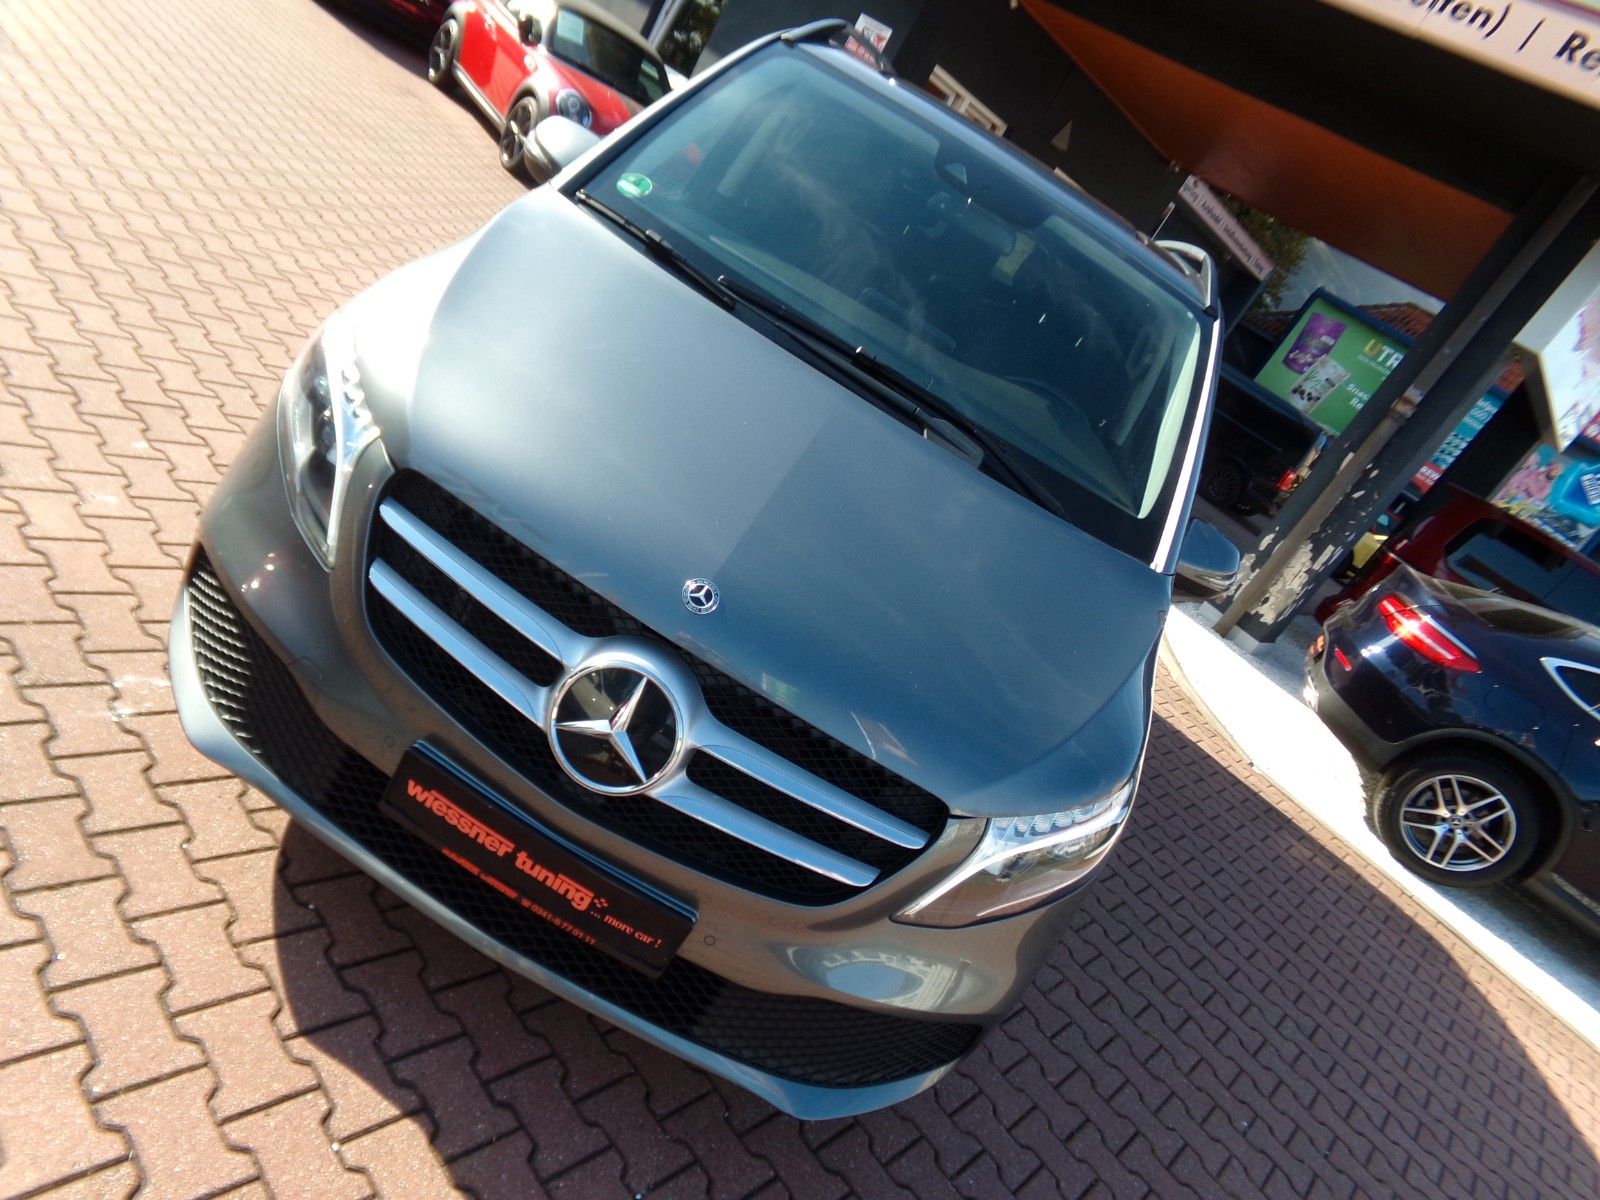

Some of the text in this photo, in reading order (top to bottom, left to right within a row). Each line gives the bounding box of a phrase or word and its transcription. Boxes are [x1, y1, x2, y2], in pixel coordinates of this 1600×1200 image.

[406, 778, 516, 858] wiessner
[514, 849, 595, 911] tuning
[603, 914, 634, 936] more
[634, 931, 655, 945] car
